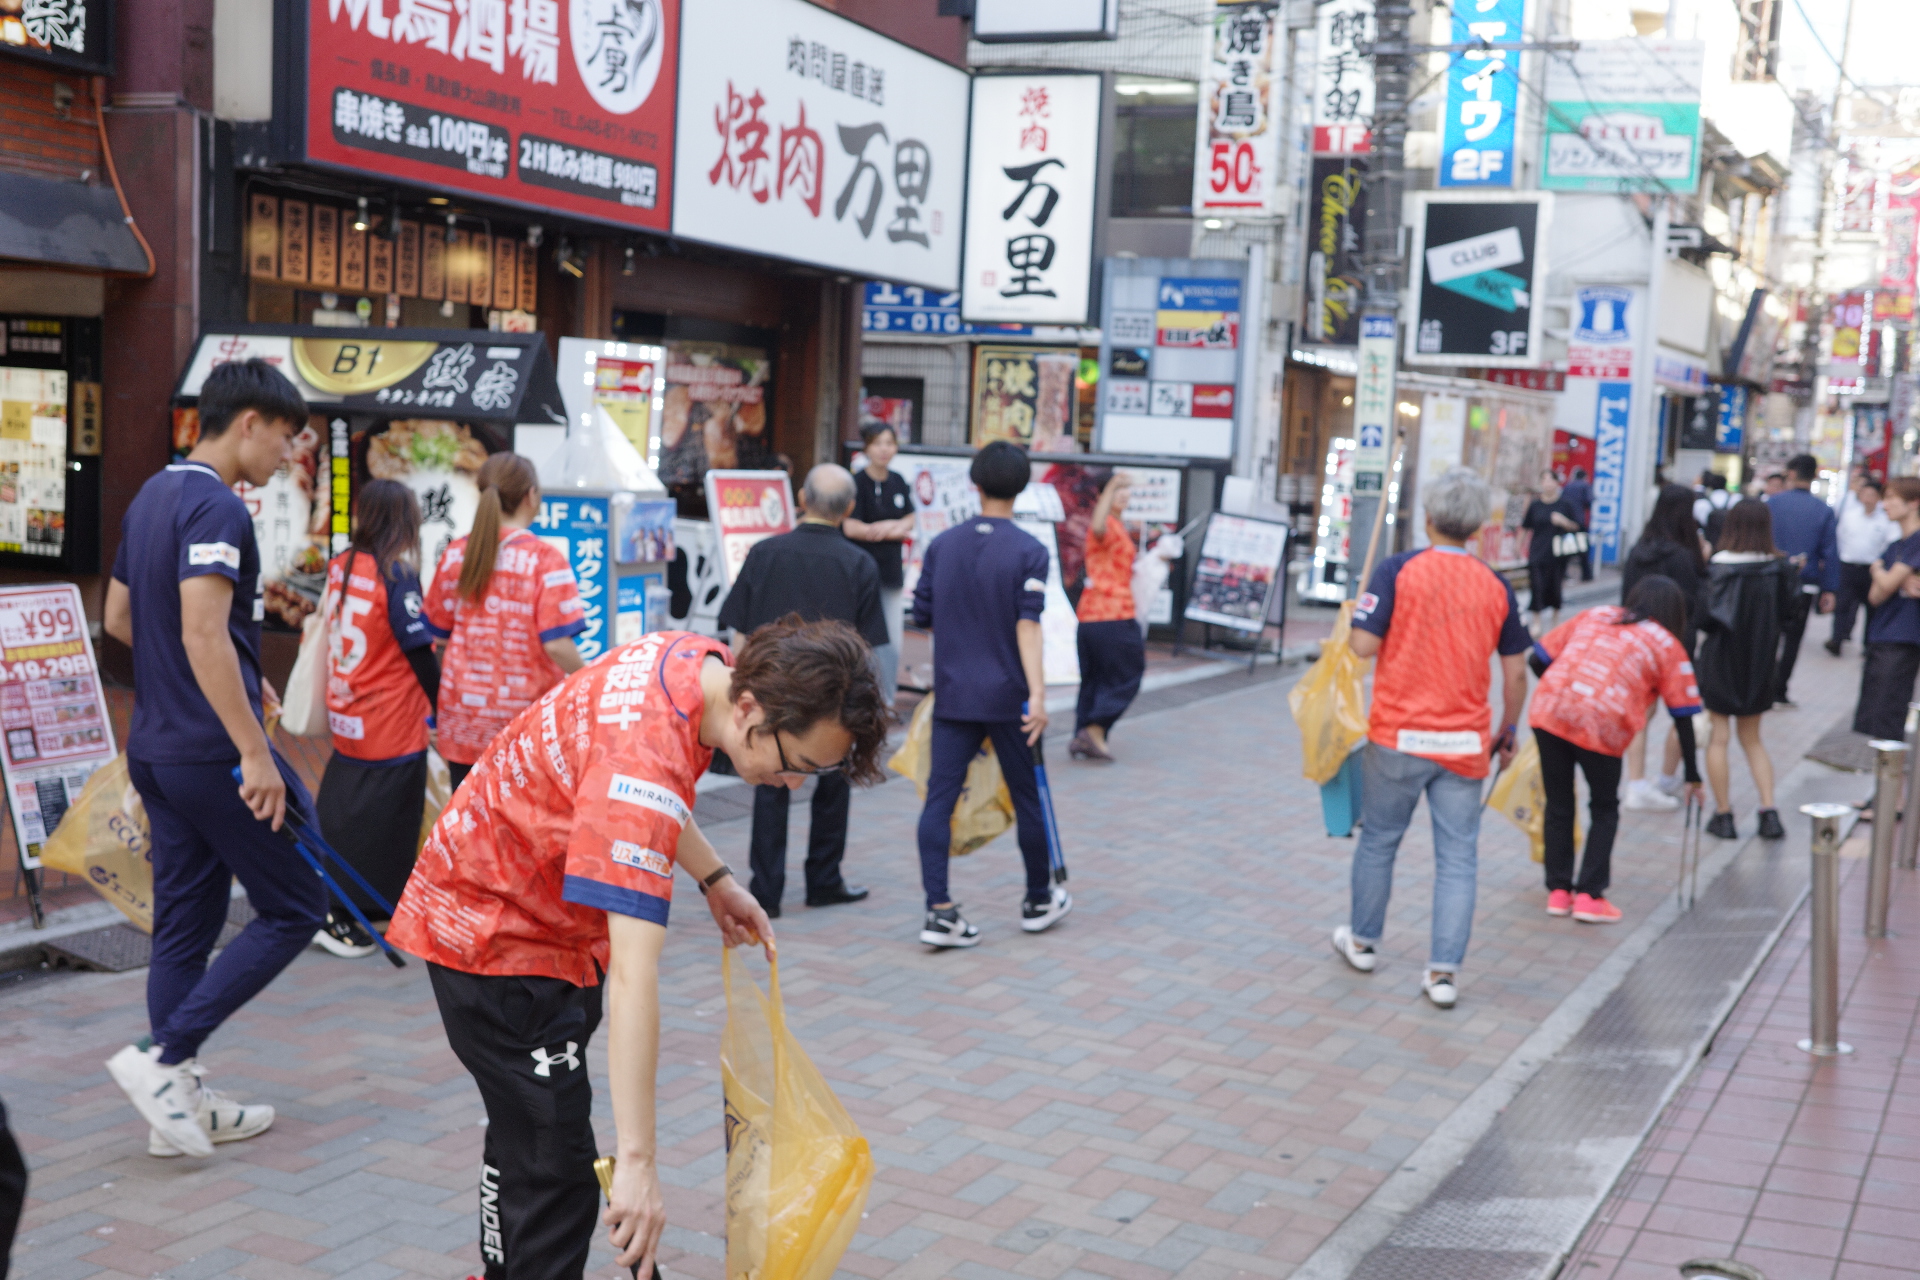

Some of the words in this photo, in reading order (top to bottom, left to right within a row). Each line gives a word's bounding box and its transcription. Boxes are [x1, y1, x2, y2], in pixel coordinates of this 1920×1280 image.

[787, 35, 887, 106] 肉問屋直送
[1221, 15, 1260, 127] 焼き鳥
[1018, 86, 1051, 152] 焼肉
[1326, 126, 1364, 152] 1F
[1451, 149, 1504, 181] 2F
[1000, 158, 1066, 299] 万里
[1450, 243, 1499, 267] CLUB
[1489, 330, 1528, 355] 3F
[332, 344, 381, 375] B1
[1590, 396, 1629, 548] LAWSON
[20, 607, 76, 640] ¥99
[632, 785, 675, 807] MIRAIT
